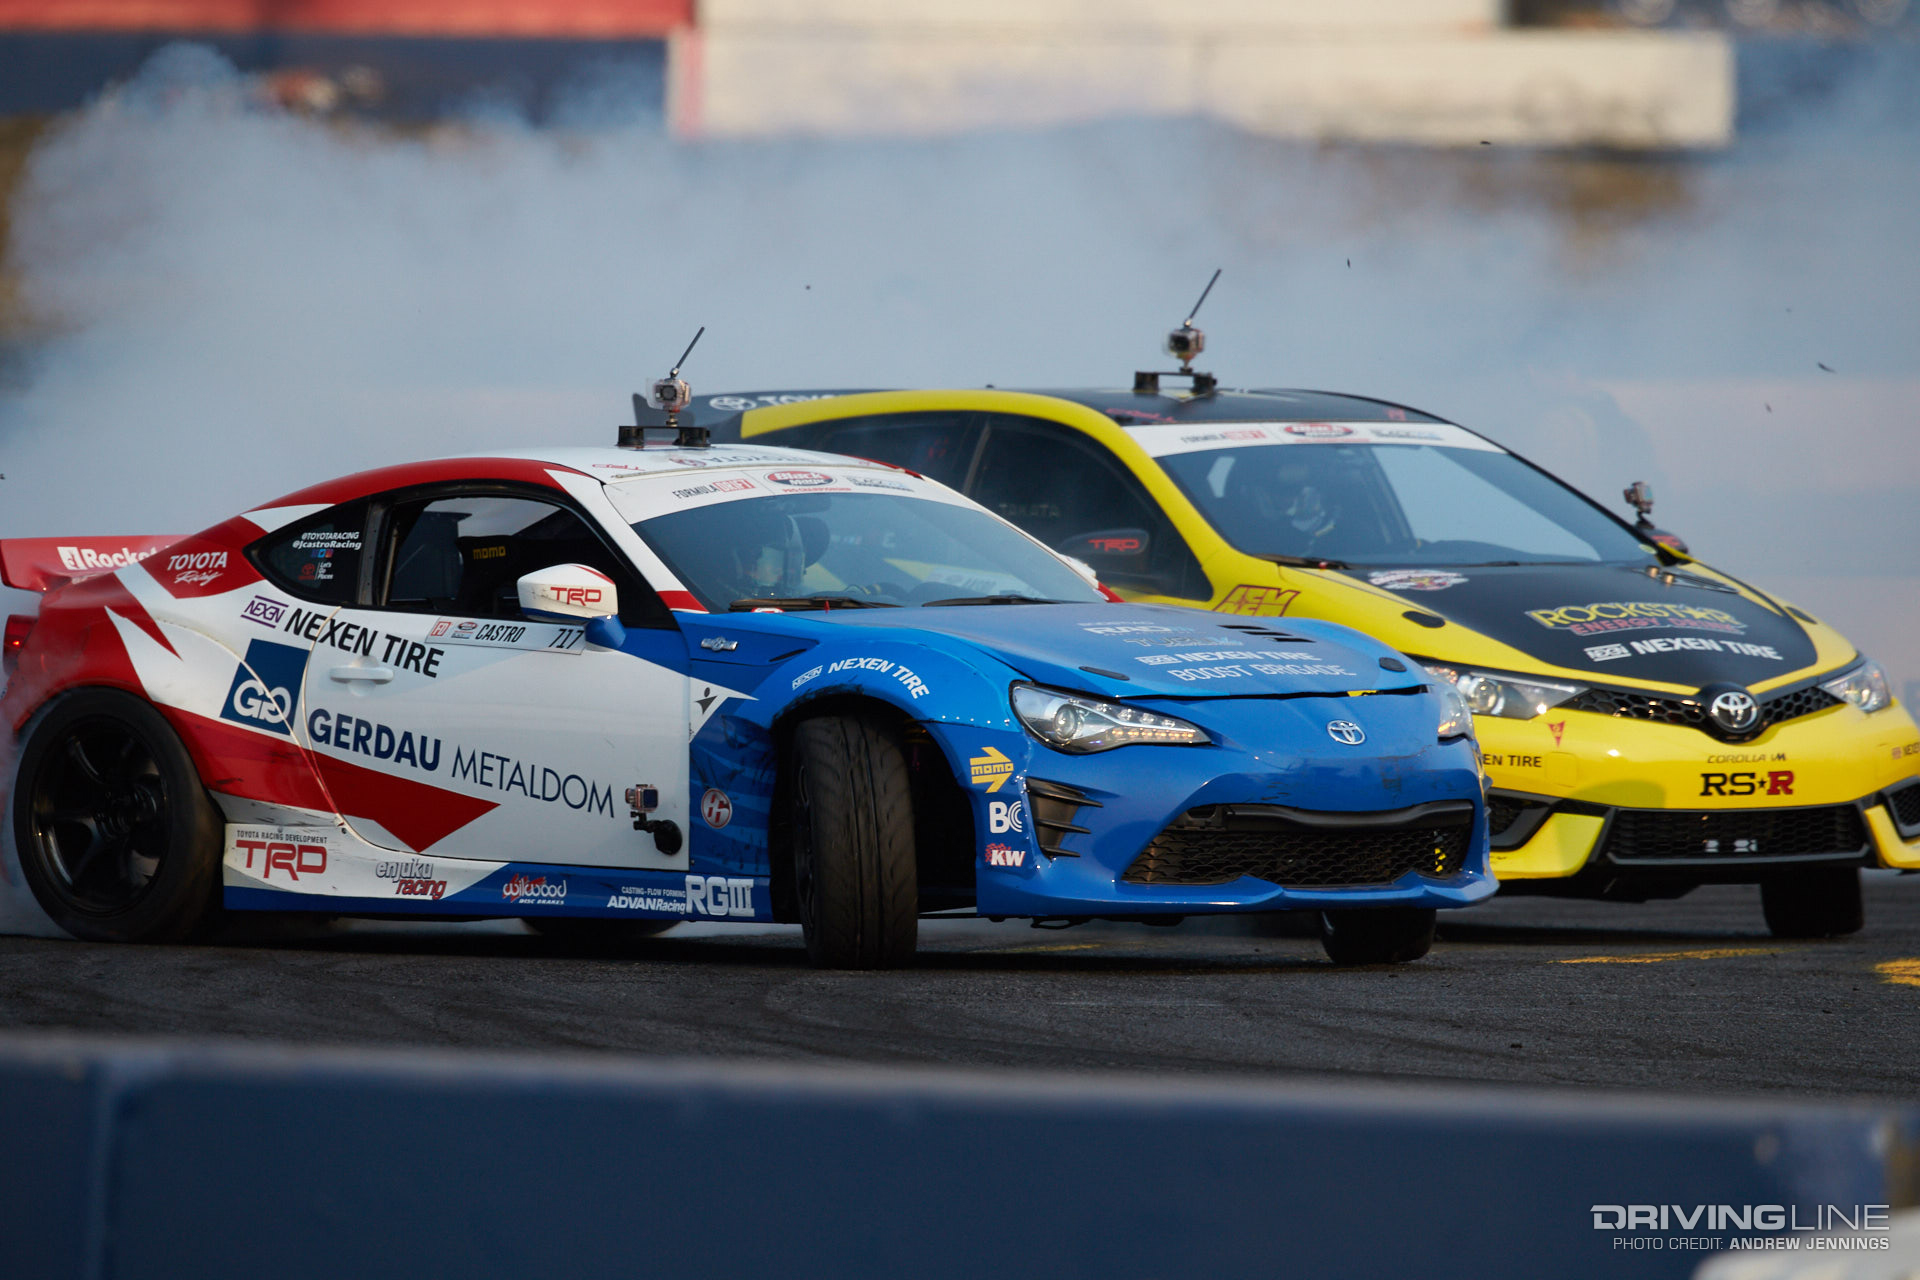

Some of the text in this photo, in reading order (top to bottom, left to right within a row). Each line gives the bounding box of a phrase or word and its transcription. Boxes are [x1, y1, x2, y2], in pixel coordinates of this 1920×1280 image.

[672, 482, 718, 499] FORMULA
[301, 531, 360, 540] @TOYOTARACING
[1088, 537, 1140, 552] TRD
[167, 552, 228, 571] TOYOTA
[550, 586, 602, 607] TRD
[242, 597, 288, 626] NEXEN
[475, 624, 526, 643] CASTRO
[1570, 616, 1657, 634] ENERGY
[284, 607, 444, 679] NEXEN TIRE
[548, 628, 584, 650] 717
[1175, 650, 1265, 663] NEXEN
[1258, 650, 1322, 661] TIRE
[1630, 637, 1724, 655] NEXEN
[1718, 640, 1783, 661] TIRE
[827, 657, 896, 674] NEXEN
[892, 664, 930, 700] TIRE
[1167, 664, 1357, 681] BOOST BRIGADE
[308, 707, 615, 819] GERDAU METALDOM
[1507, 754, 1543, 769] TIRE
[1707, 754, 1767, 764] COROLLA
[971, 763, 1014, 775] momo
[236, 829, 328, 844] TOYOTA RACING DEVELOPMENT
[236, 839, 327, 881] TRD
[990, 849, 1025, 867] KW
[375, 857, 434, 882] enjuku
[395, 879, 448, 900] racing
[502, 879, 568, 901] wilwood
